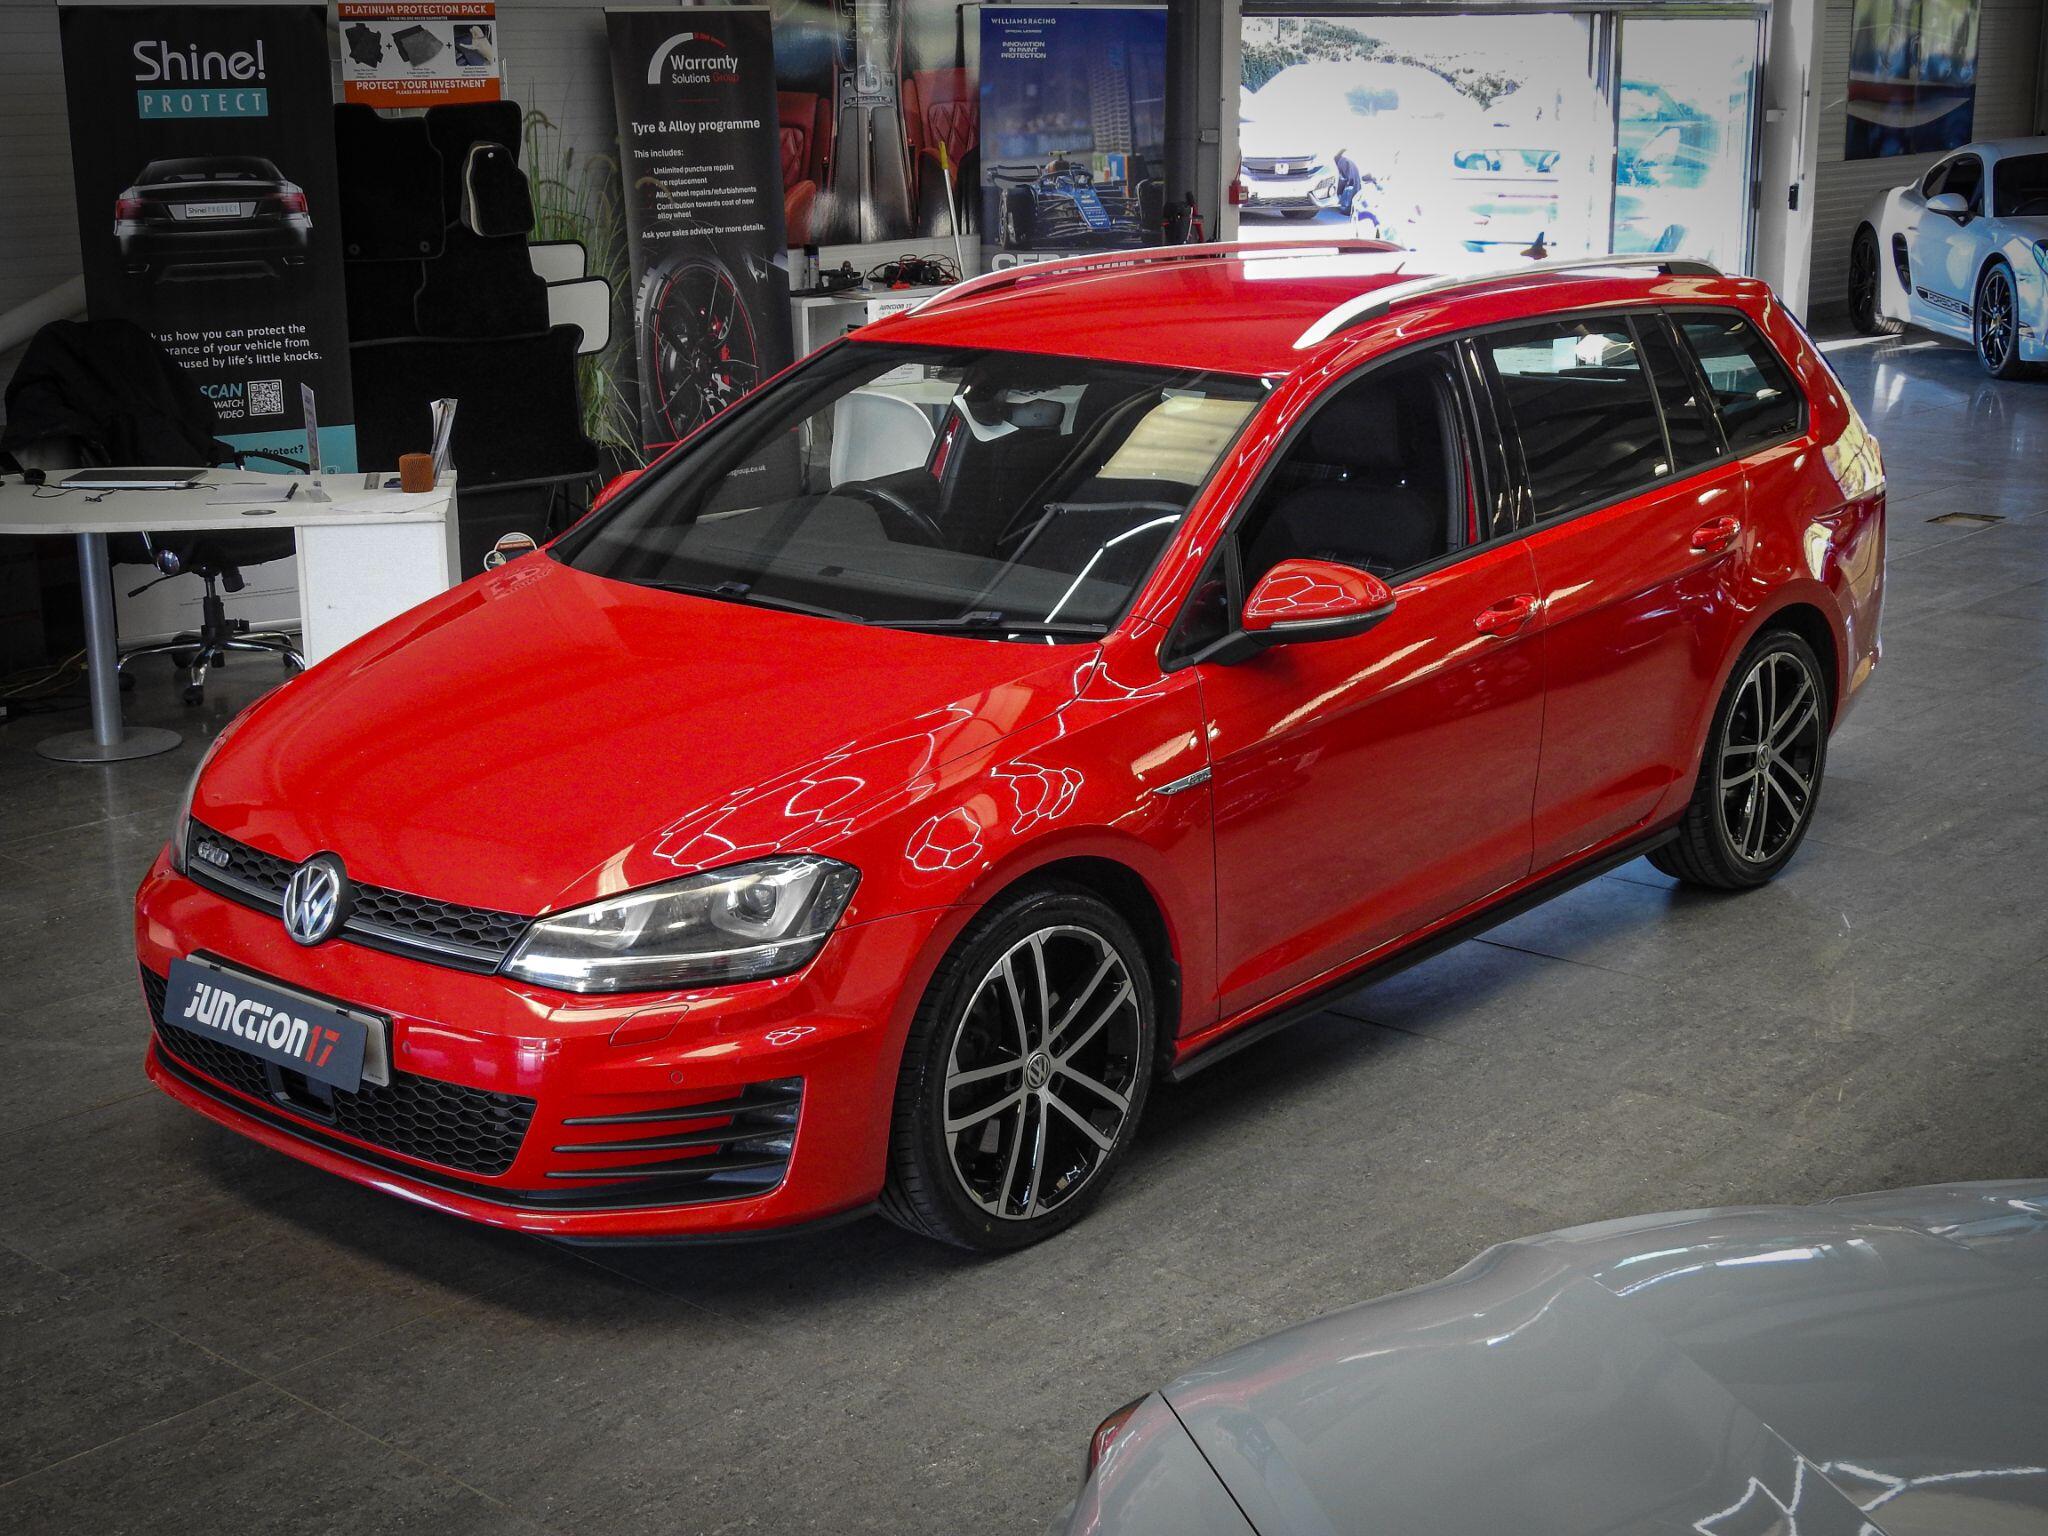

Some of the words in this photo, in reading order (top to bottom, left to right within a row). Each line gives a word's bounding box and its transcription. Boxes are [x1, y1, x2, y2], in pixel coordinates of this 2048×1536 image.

[345, 5, 394, 14] PLATINUM
[397, 5, 459, 14] PROTECTION
[462, 5, 487, 13] PACK
[133, 39, 266, 81] Shine!
[670, 54, 738, 74] Warranty
[671, 73, 711, 84] Solutions
[356, 81, 400, 90] PROTECT
[401, 81, 427, 90] YOUR
[429, 80, 487, 89] INVESTMENT
[143, 93, 262, 113] PROTECT
[632, 122, 656, 136] Tyre
[658, 121, 667, 132] &
[668, 120, 696, 134] Alloy
[698, 118, 761, 132] programme
[634, 150, 649, 158] This
[650, 149, 684, 158] includes:
[653, 166, 684, 175] Unlimited
[684, 165, 713, 175] puncture
[713, 163, 734, 173] repairs
[668, 177, 708, 187] replacement
[671, 189, 690, 197] wheel
[695, 199, 721, 208] towards
[721, 198, 734, 206] cost
[734, 197, 741, 205] of
[657, 212, 673, 221] alloy
[673, 210, 692, 219] wheel
[642, 231, 655, 239] Ask
[655, 230, 671, 240] your
[672, 228, 689, 237] sales
[689, 227, 714, 236] advisor
[714, 225, 724, 234] for
[724, 224, 742, 233] more
[742, 223, 766, 232] details.
[1928, 292, 1962, 312] PORSCHE
[160, 334, 173, 342] us
[176, 330, 199, 341] how
[202, 330, 222, 343] you
[225, 329, 244, 338] can
[247, 326, 285, 340] protect
[288, 323, 306, 334] the
[203, 343, 214, 353] of
[217, 343, 241, 356] your
[244, 339, 282, 351] vehicle
[284, 337, 310, 348] from
[212, 356, 225, 370] by
[256, 352, 281, 364] little
[283, 351, 323, 362] knocks.
[213, 399, 245, 409] WATCH
[217, 409, 245, 420] VIDEO
